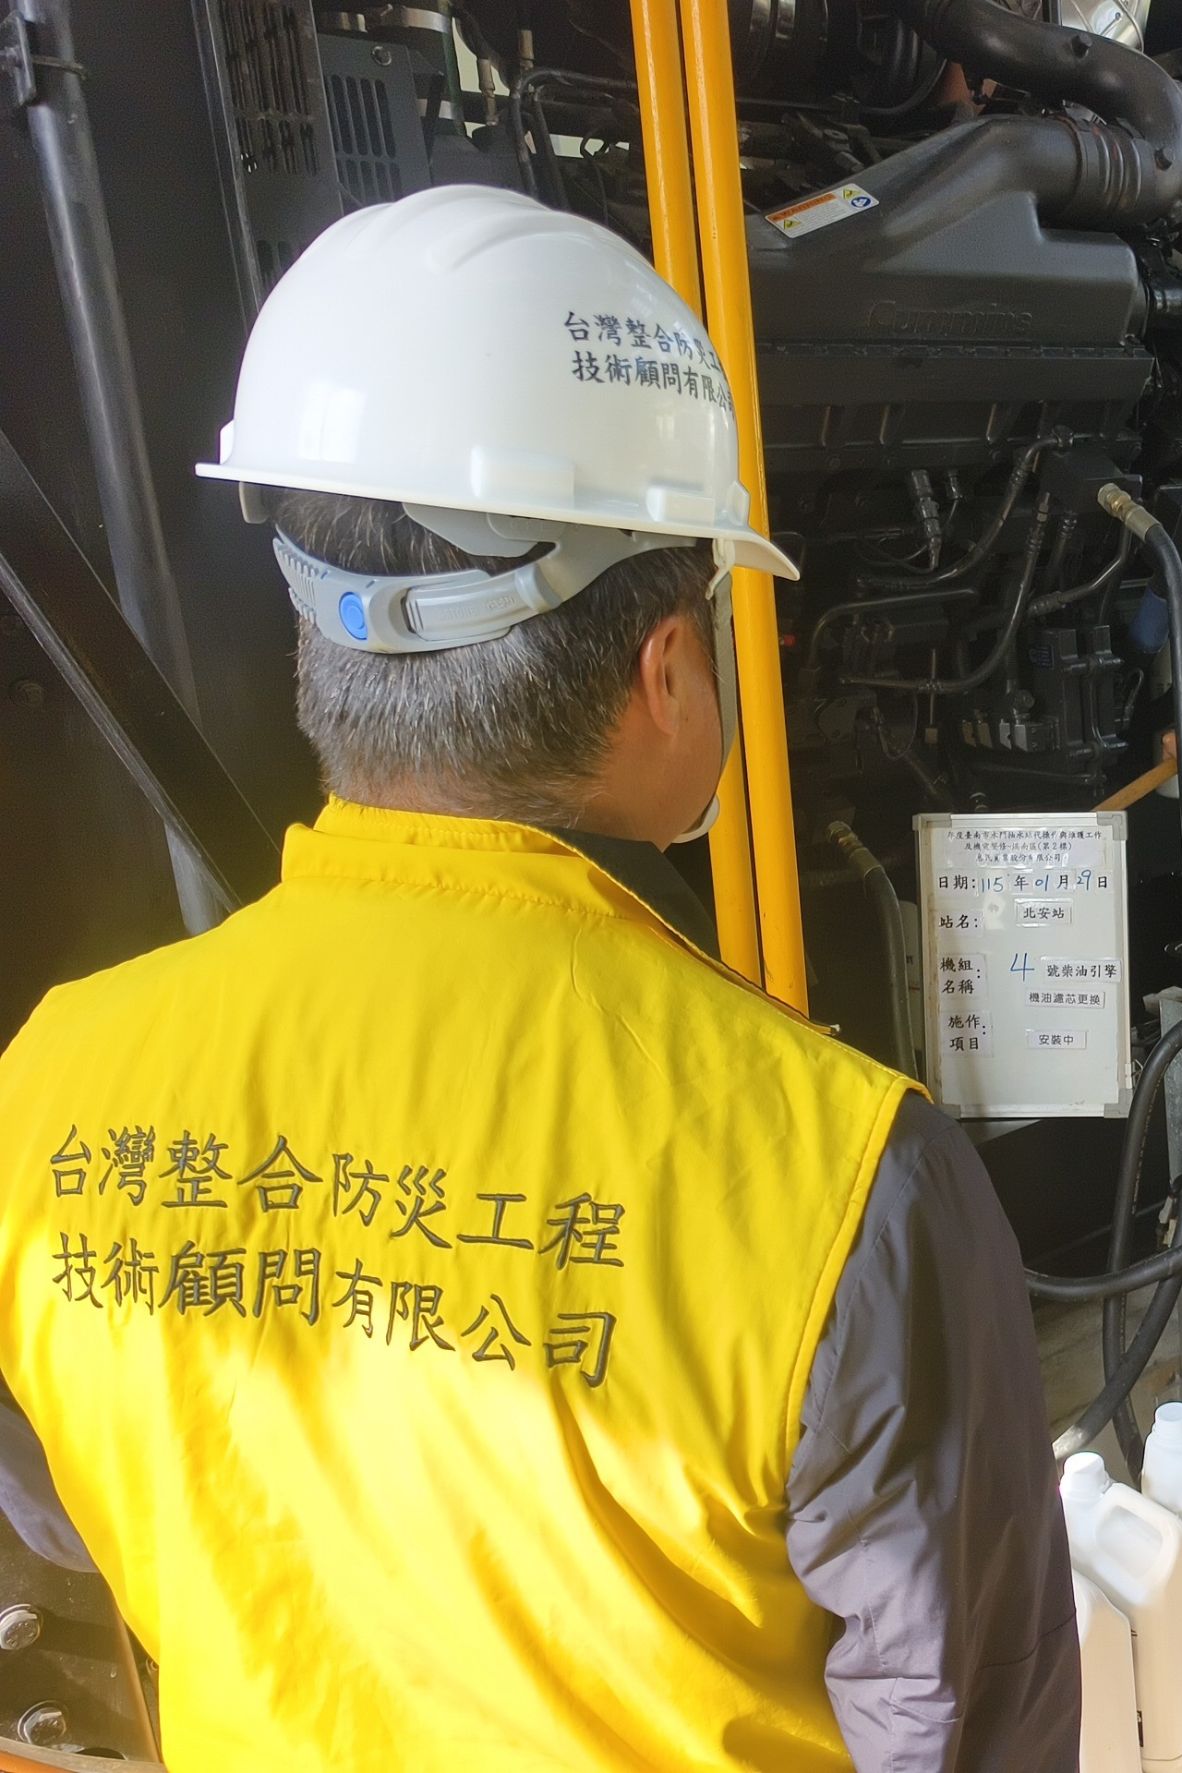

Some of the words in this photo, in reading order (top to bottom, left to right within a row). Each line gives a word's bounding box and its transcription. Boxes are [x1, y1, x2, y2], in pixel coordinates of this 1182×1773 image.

[1023, 907, 1065, 919] 北安站
[1010, 953, 1035, 982] 4
[1047, 964, 1117, 978] 號柴油引擎
[1029, 991, 1101, 1005] 機油濾芯更換
[1038, 1034, 1074, 1046] 安裝中
[50, 1124, 625, 1271] 台灣整合防災工程
[51, 1232, 617, 1389] 技術顧問有限公司
